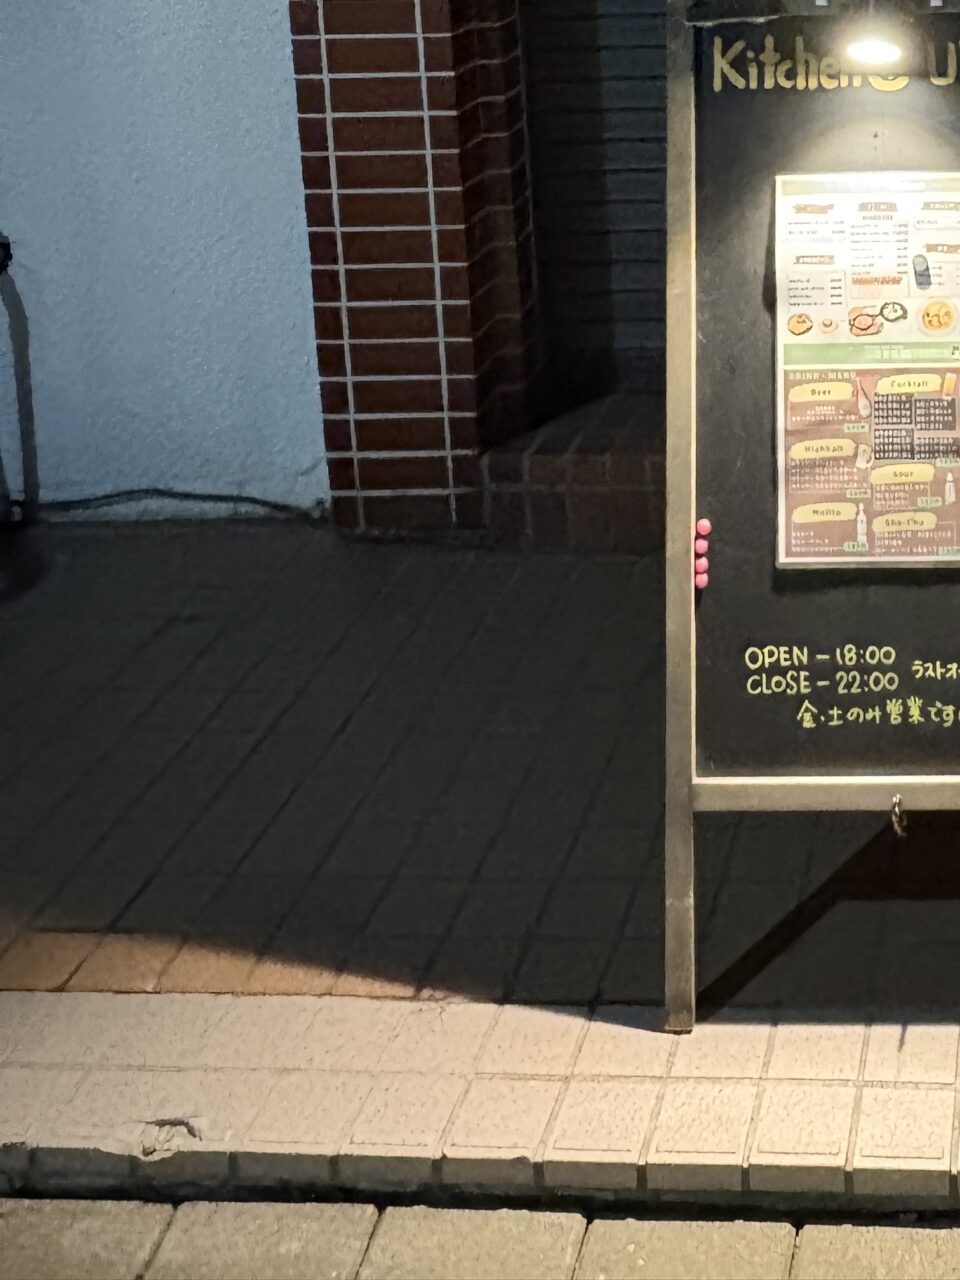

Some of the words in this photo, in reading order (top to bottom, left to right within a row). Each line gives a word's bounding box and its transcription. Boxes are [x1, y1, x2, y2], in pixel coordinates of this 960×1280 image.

[745, 645, 808, 670] OPEN
[836, 644, 896, 666] 18:00
[746, 671, 812, 695] CLOSE
[836, 671, 899, 695] 22:00
